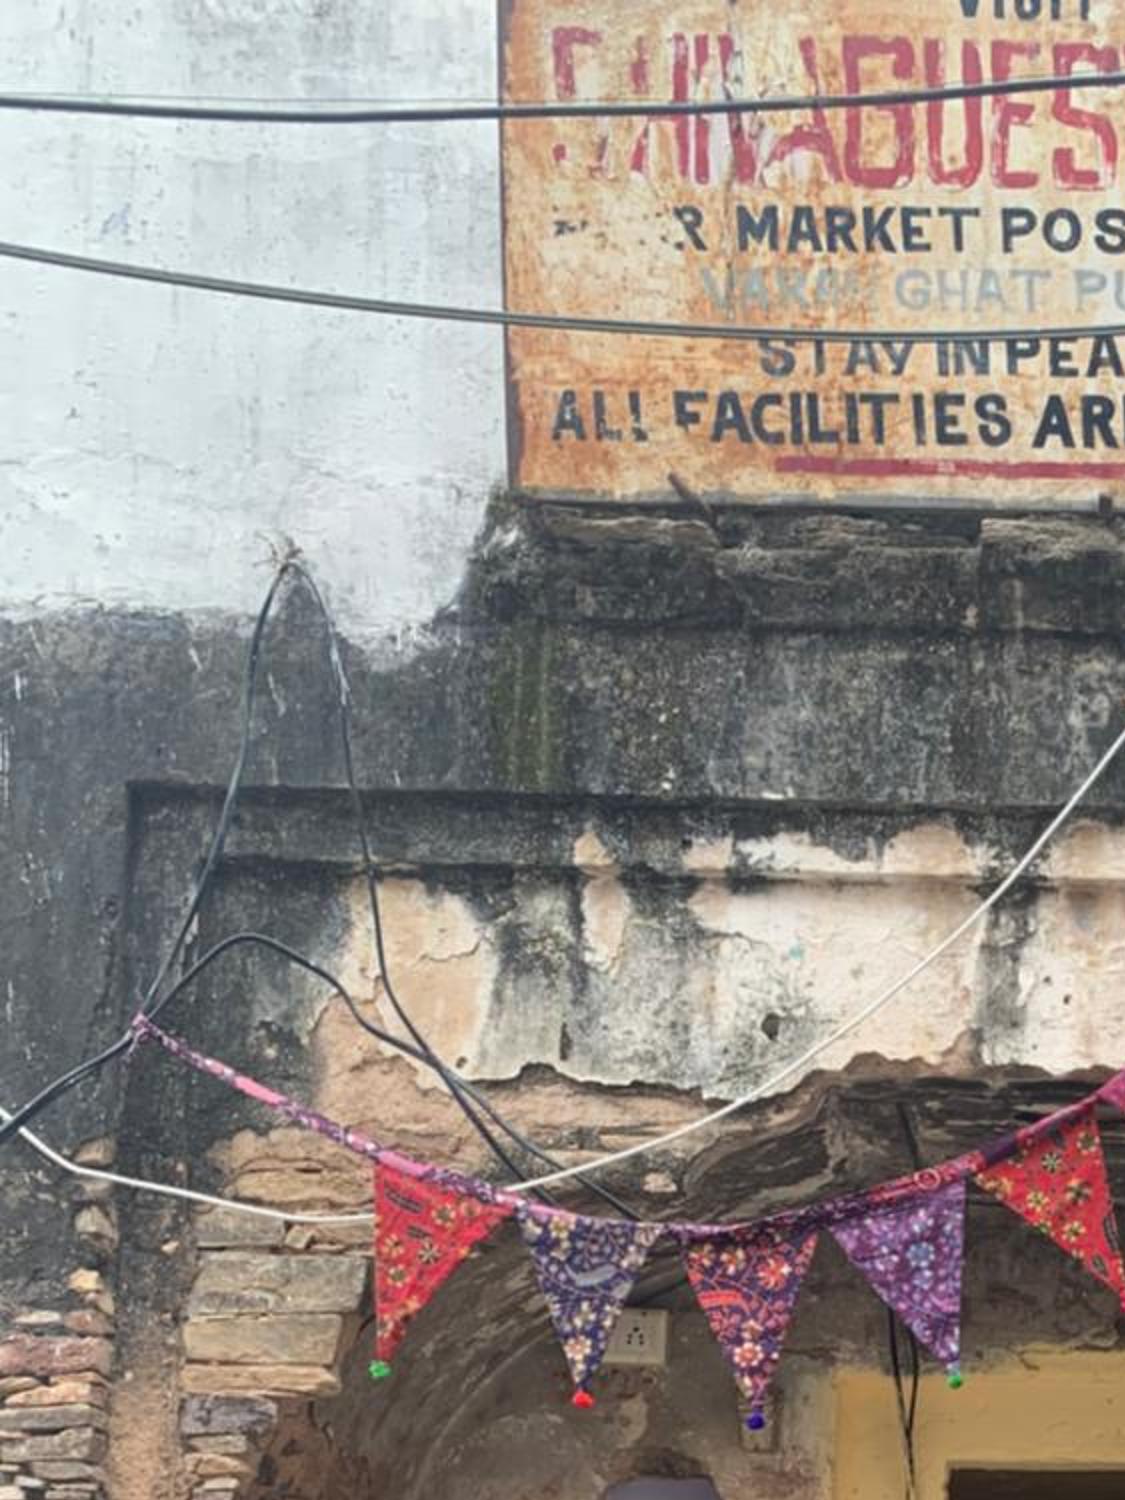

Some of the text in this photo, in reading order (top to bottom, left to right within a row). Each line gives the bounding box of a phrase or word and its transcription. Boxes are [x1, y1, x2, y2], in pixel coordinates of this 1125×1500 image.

[735, 204, 980, 253] MARKET
[894, 267, 1051, 313] GHAT
[757, 333, 914, 378] STAY
[936, 335, 990, 378] IN
[673, 388, 1013, 448] FACILITIES
